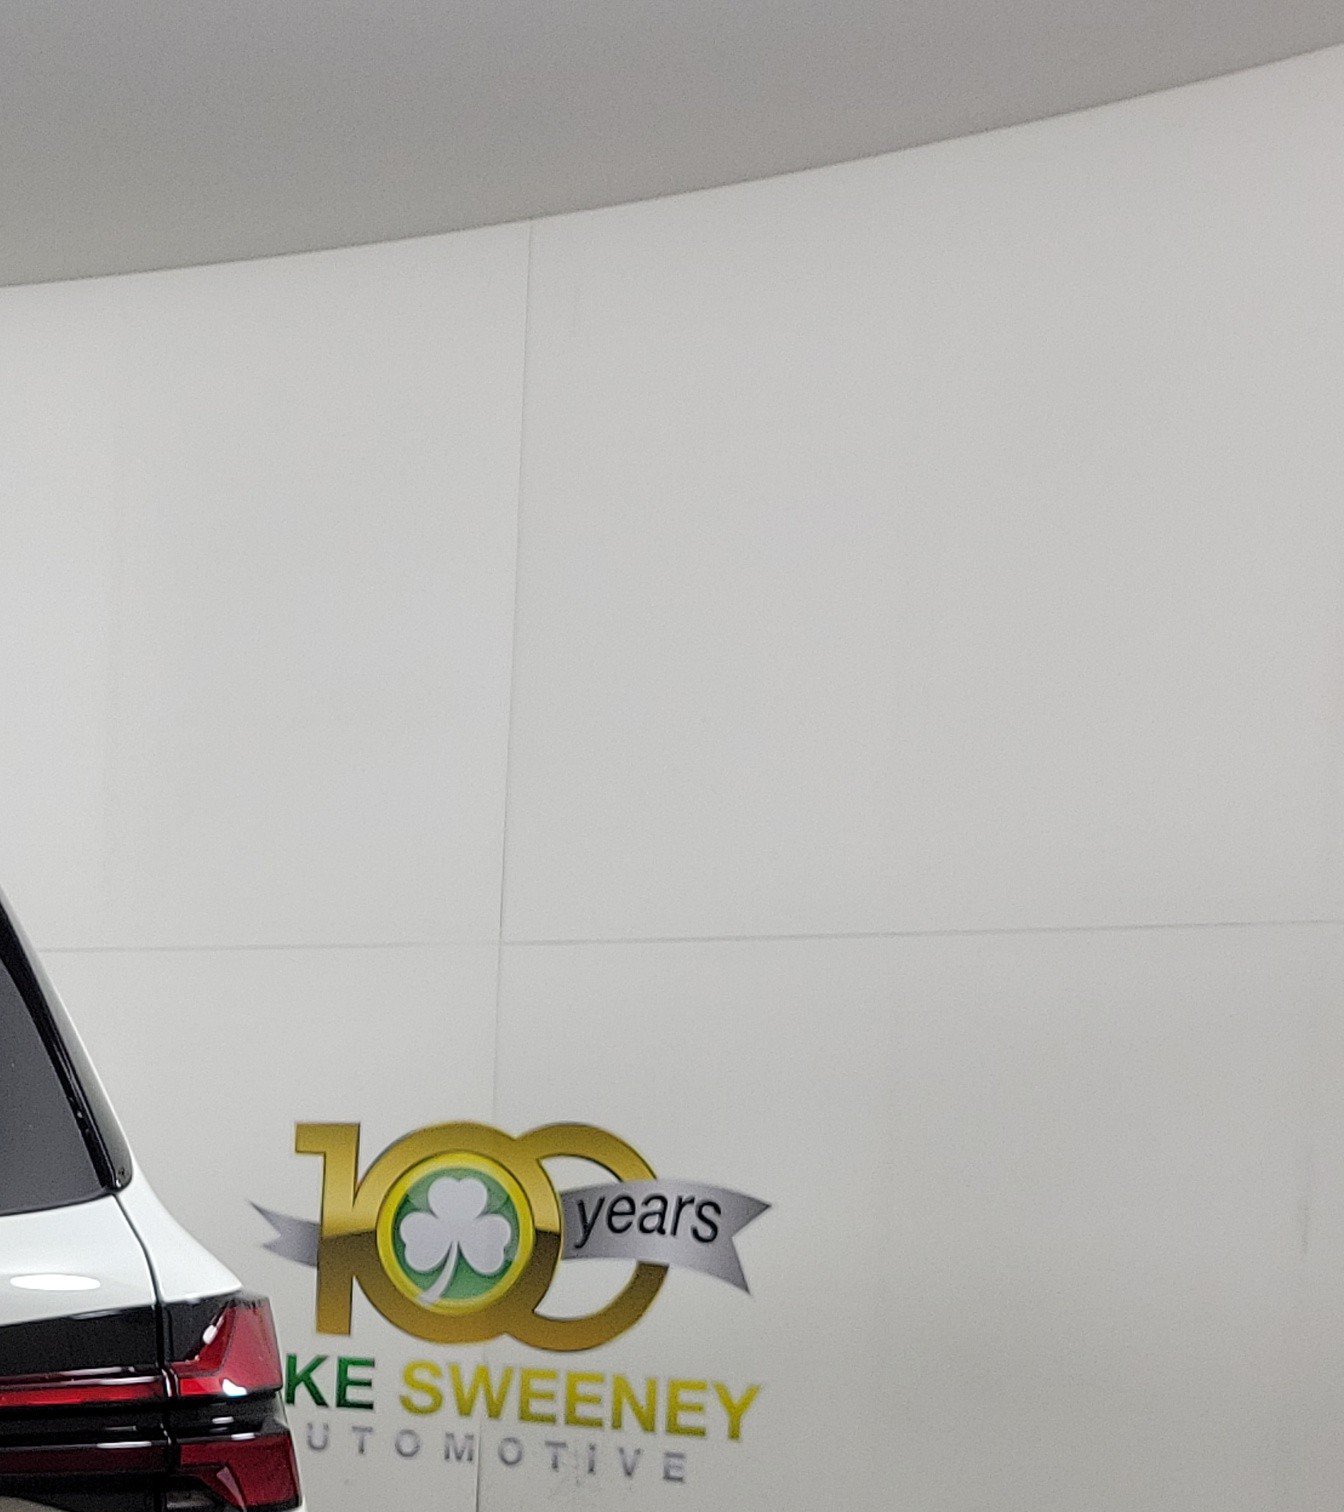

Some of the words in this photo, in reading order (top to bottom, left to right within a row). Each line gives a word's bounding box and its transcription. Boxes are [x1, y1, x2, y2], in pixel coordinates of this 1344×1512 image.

[573, 1192, 722, 1250] years
[284, 1353, 376, 1411] KE
[399, 1359, 762, 1442] SWEENEY
[306, 1422, 687, 1484] UTOMOTIVE
